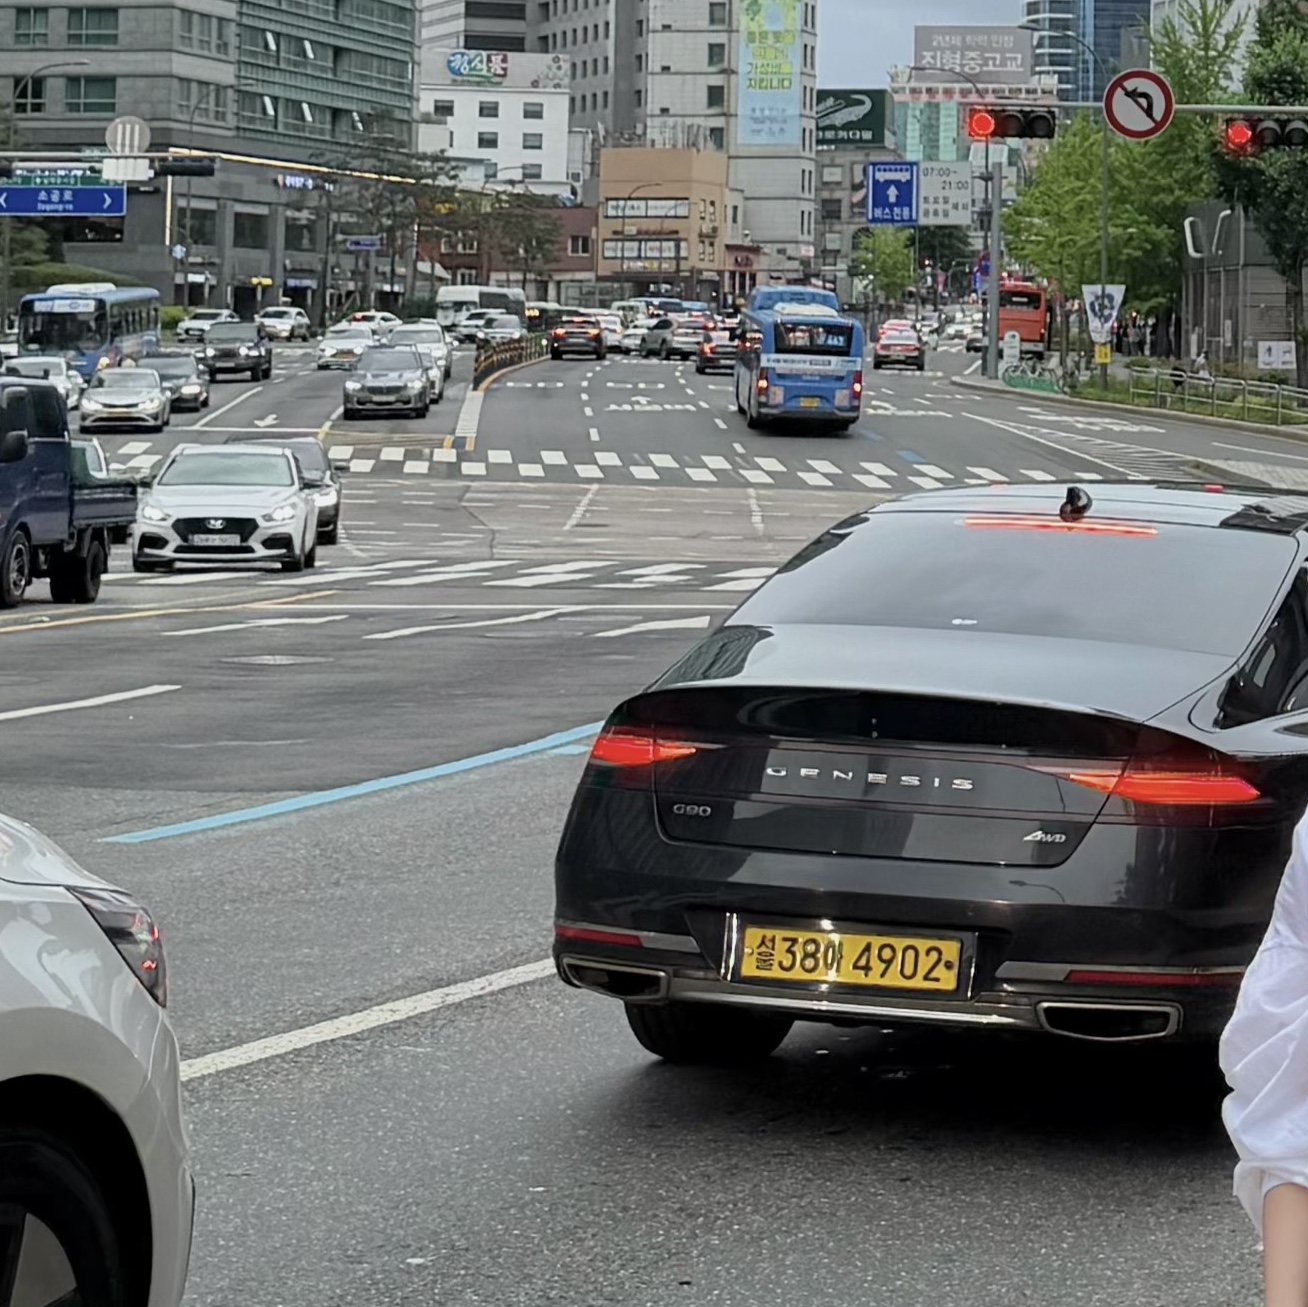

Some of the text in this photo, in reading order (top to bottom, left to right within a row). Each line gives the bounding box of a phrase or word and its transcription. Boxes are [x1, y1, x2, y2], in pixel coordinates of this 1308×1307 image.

[766, 766, 974, 791] GENESIS
[673, 803, 712, 817] G90
[852, 941, 943, 983] 4902
